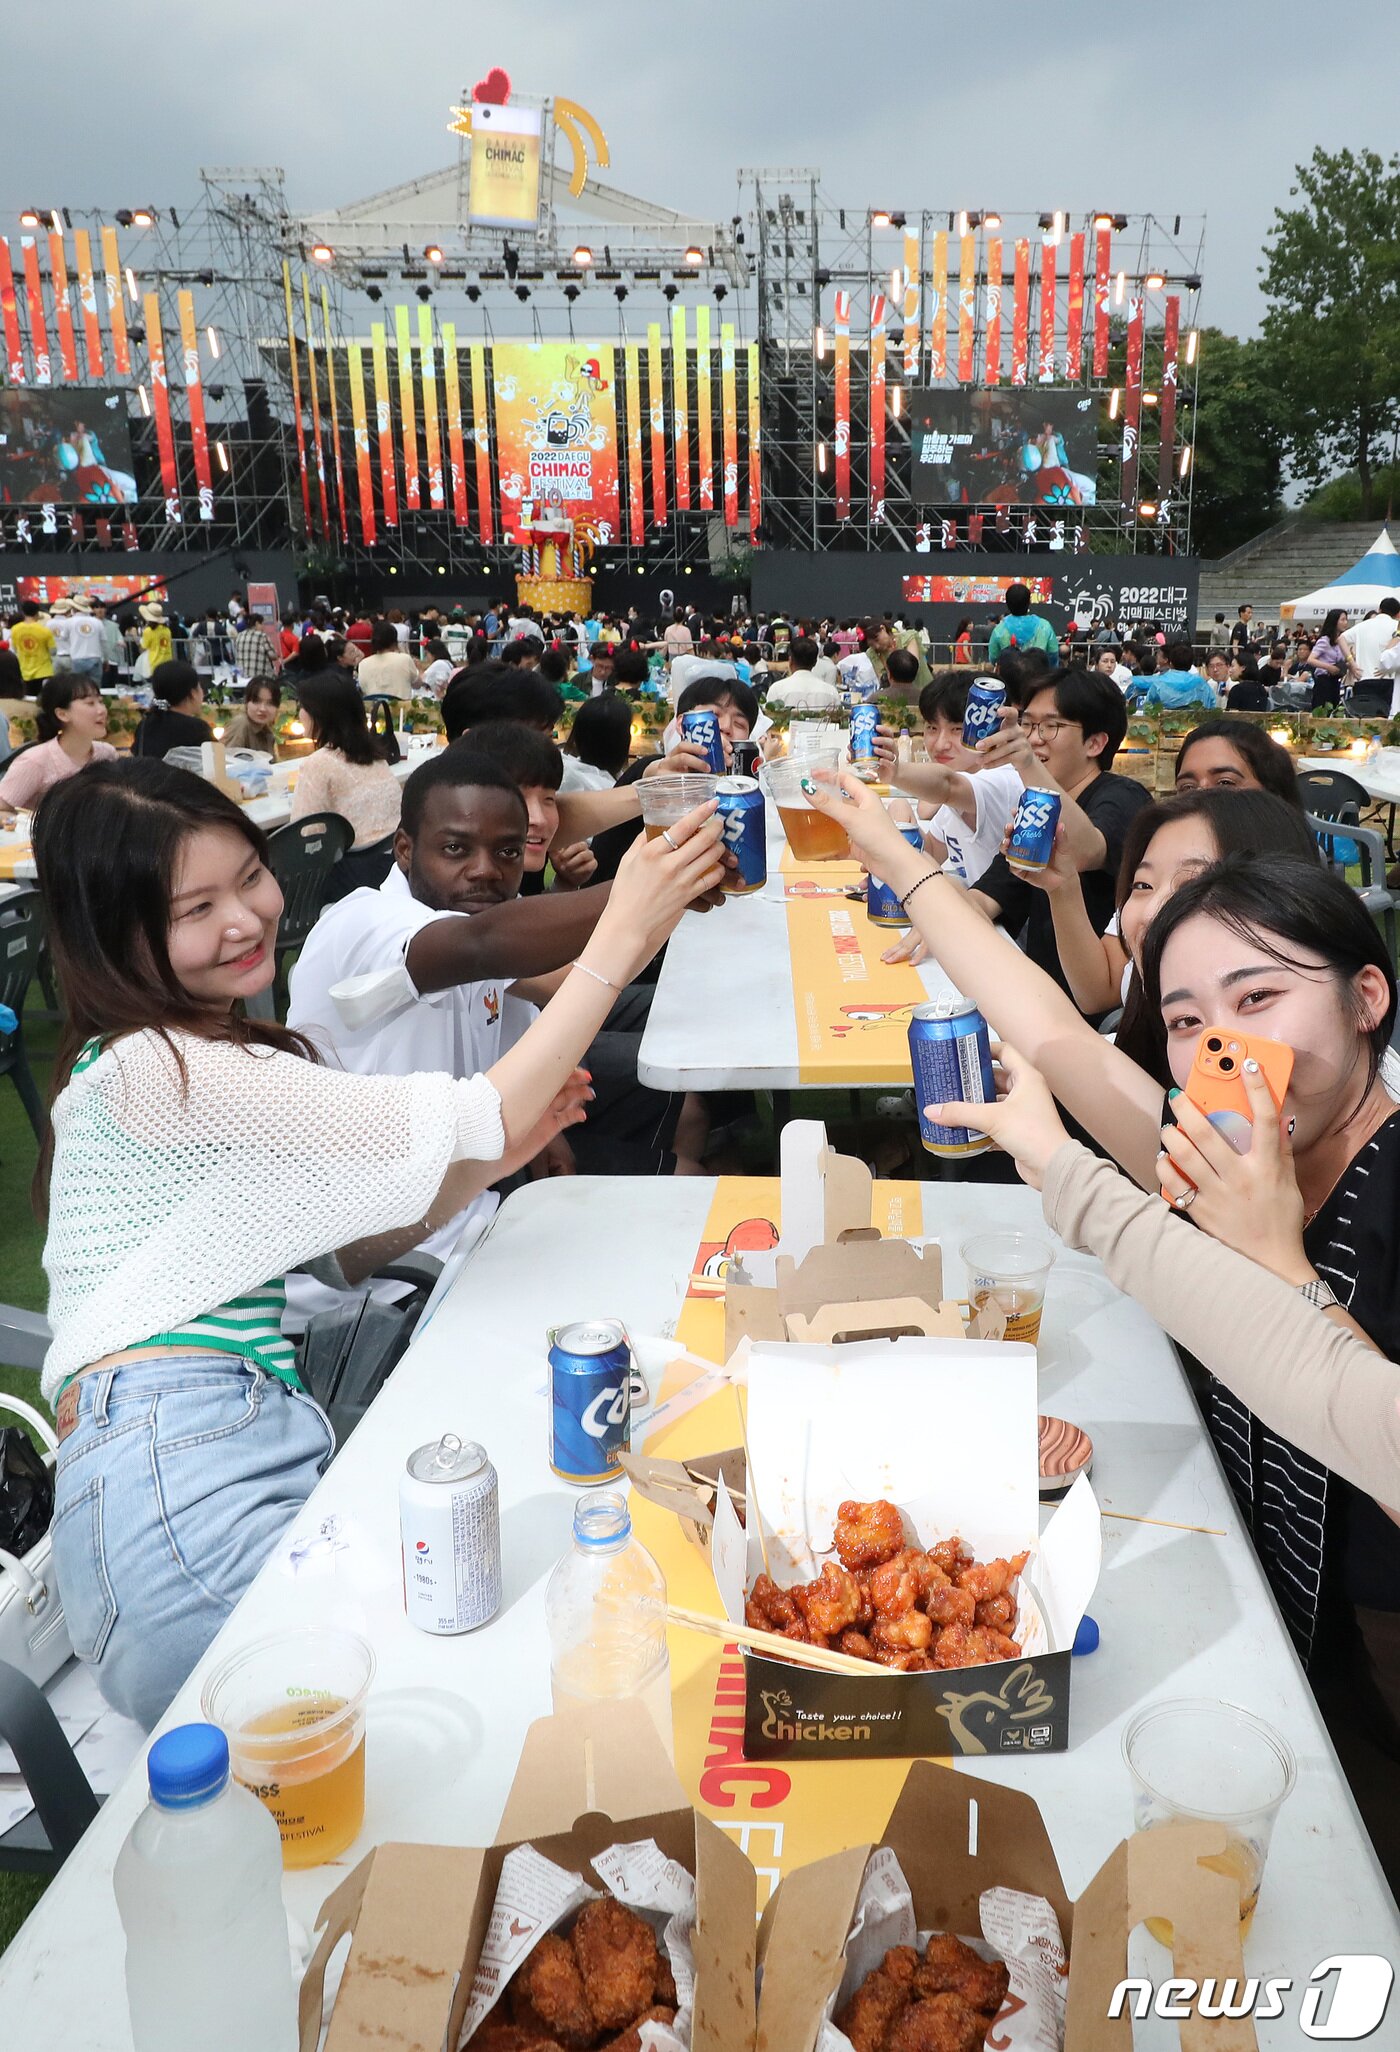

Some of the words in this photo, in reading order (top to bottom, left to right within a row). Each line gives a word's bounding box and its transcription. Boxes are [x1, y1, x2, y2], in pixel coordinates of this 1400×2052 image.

[486, 147, 525, 164] CHIMAC
[530, 462, 590, 477] CHIMAC
[796, 1709, 825, 1721] Taste
[833, 1714, 857, 1723] your
[860, 1710, 902, 1721] choice!!
[761, 1719, 871, 1741] Chicken
